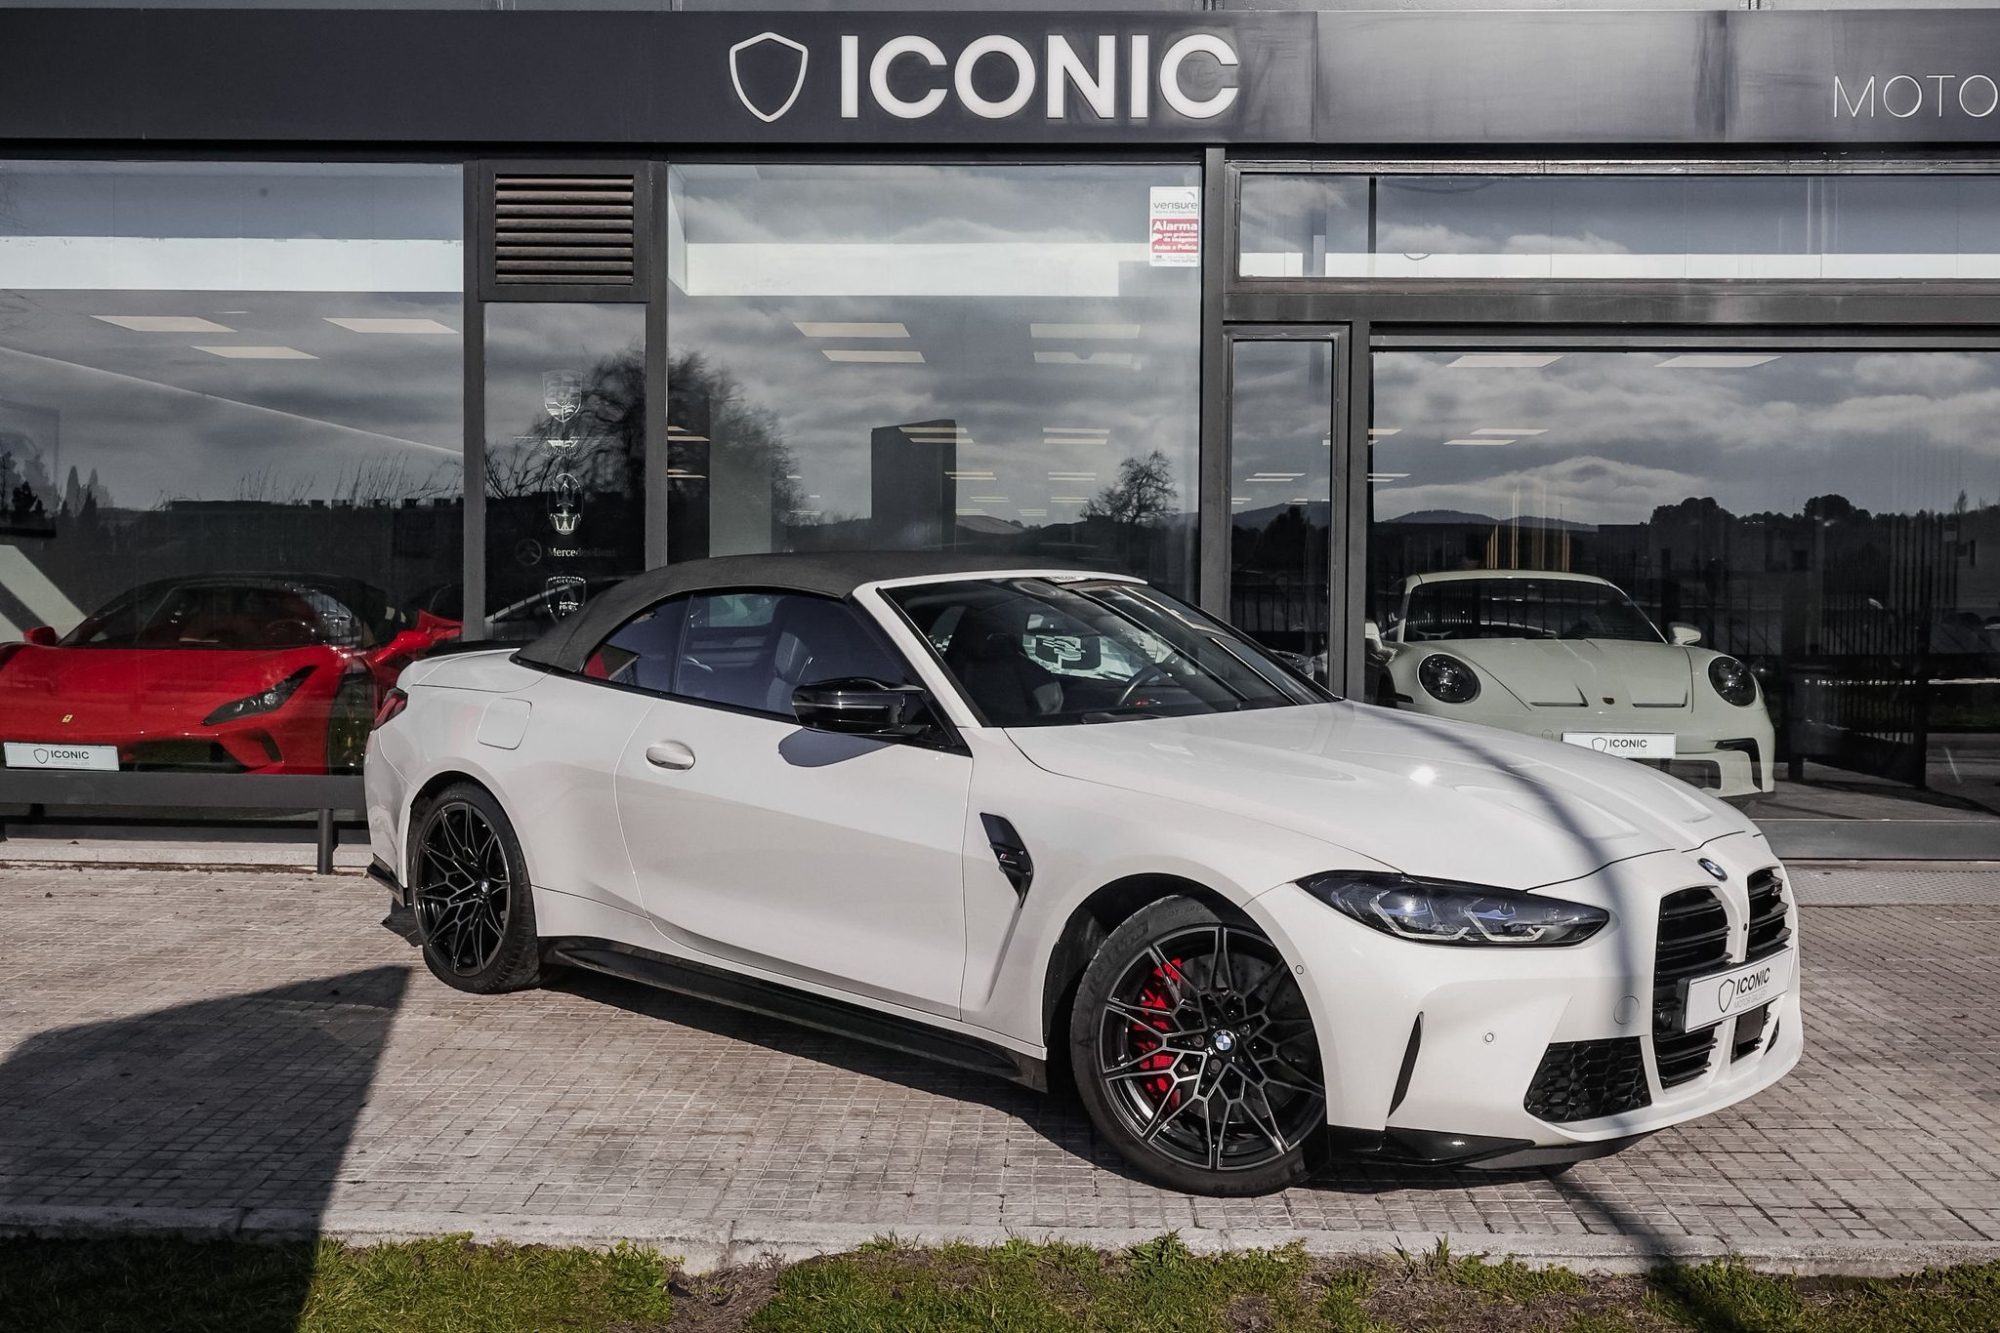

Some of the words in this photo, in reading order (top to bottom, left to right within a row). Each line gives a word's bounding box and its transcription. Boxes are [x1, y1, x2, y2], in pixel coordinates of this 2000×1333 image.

[840, 34, 1239, 119] ICONIC
[1834, 74, 1999, 118] MOTO
[1153, 201, 1198, 210] verisure
[1153, 220, 1198, 231] Alarma
[1609, 739, 1648, 748] ICONIC
[51, 749, 90, 760] ICONIC
[1736, 967, 1770, 995] ICONIC
